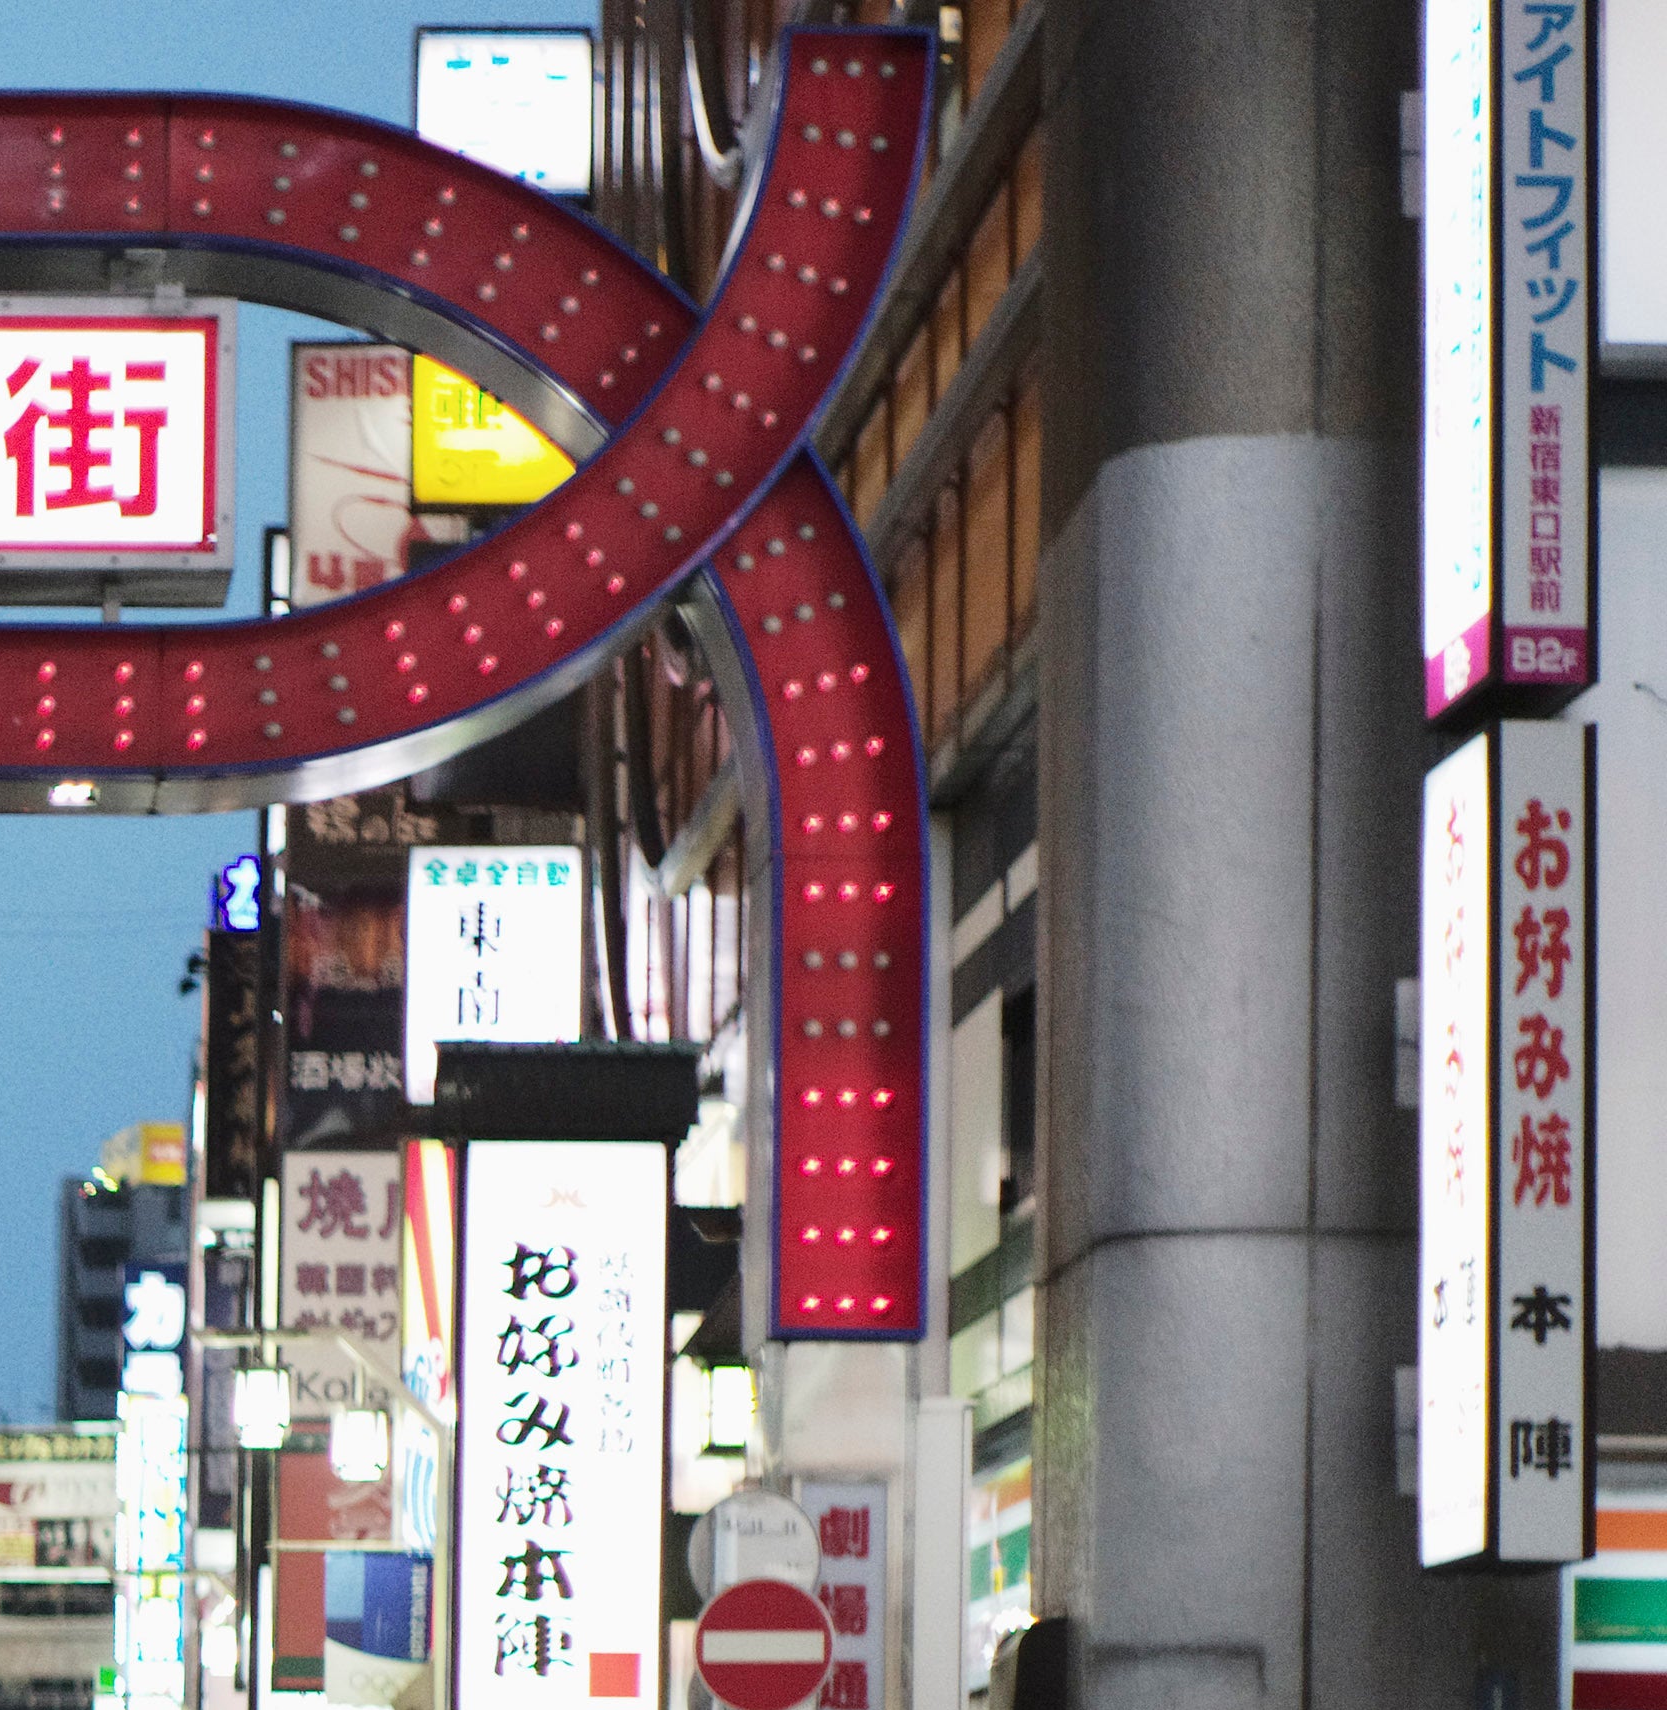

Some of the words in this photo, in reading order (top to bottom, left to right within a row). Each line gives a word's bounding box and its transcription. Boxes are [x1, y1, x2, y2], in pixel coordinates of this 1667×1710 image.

[305, 355, 413, 399] SHIS
[1529, 403, 1562, 613] 新宿東口駅前
[1512, 798, 1572, 1209] お好み焼
[297, 1167, 400, 1239] 焼
[496, 1240, 581, 1678] お好み焼本陣
[1511, 1285, 1572, 1482] 本陣
